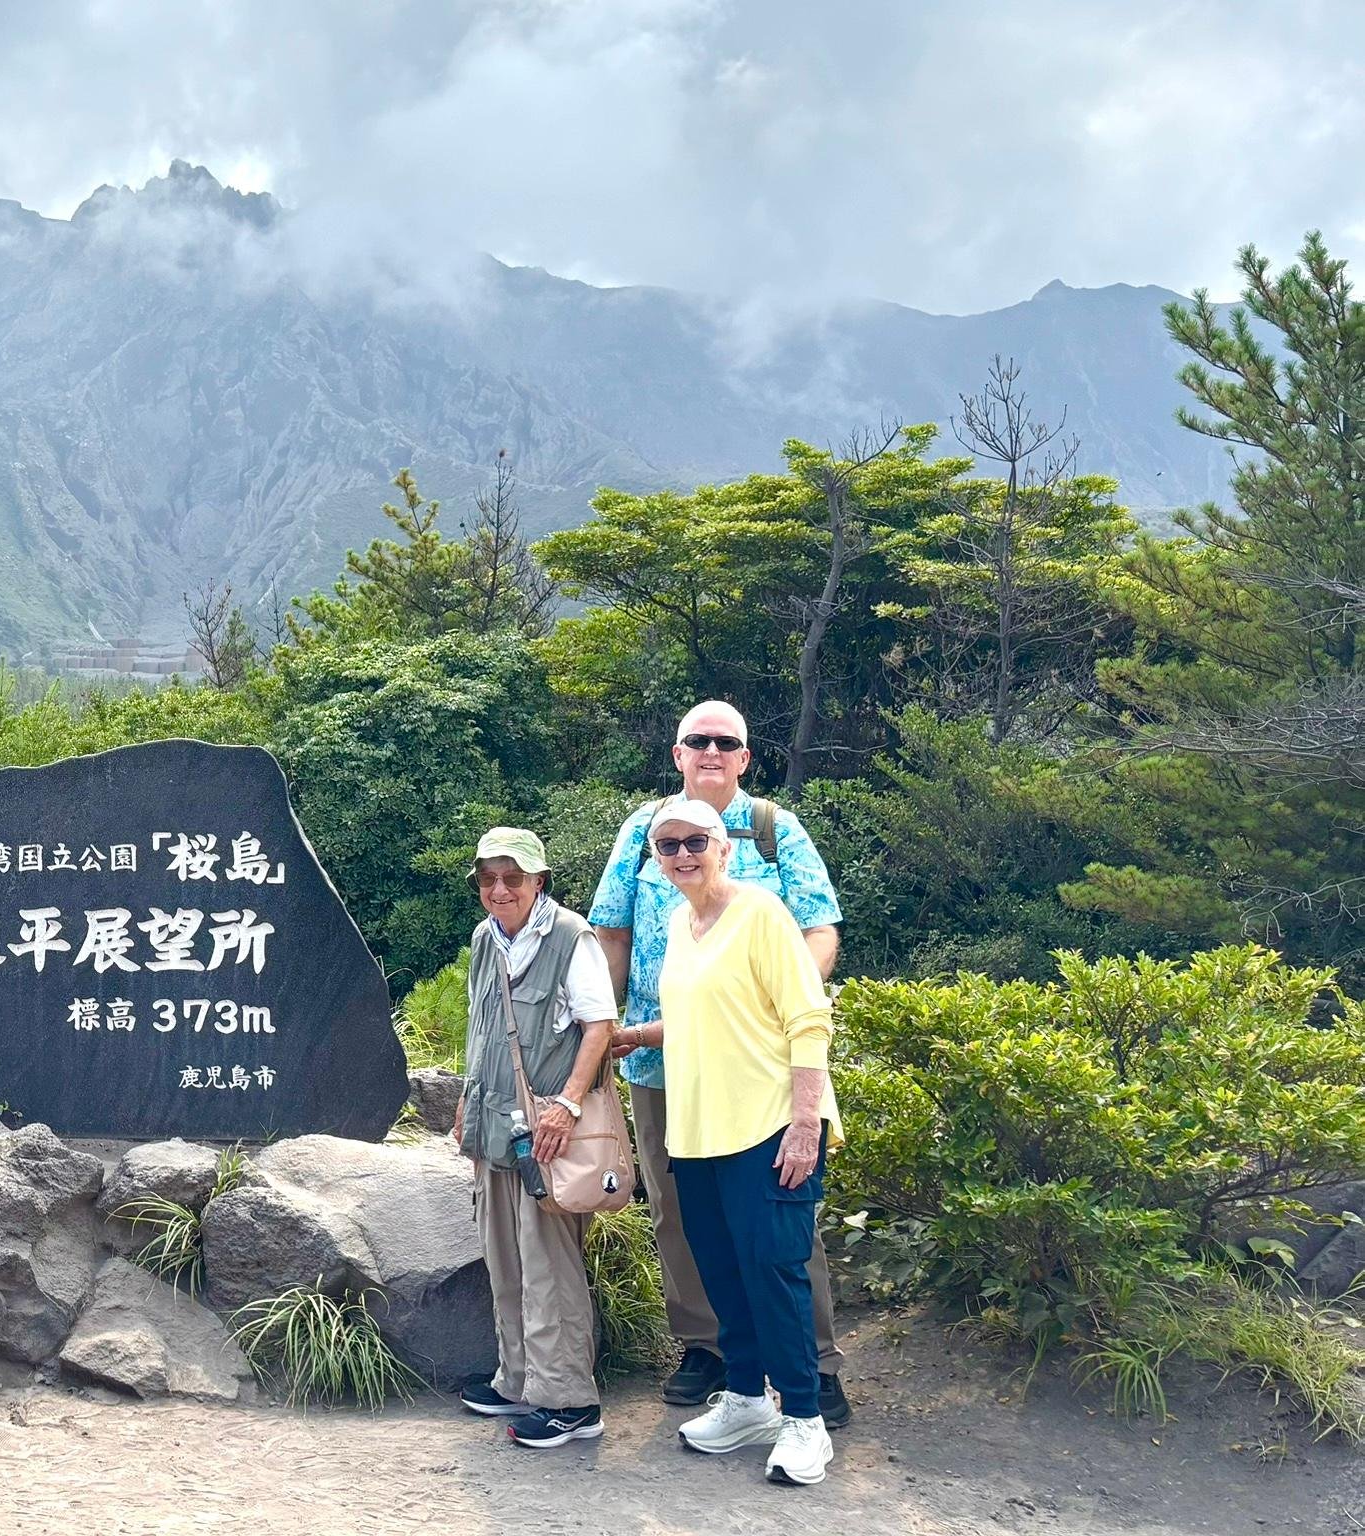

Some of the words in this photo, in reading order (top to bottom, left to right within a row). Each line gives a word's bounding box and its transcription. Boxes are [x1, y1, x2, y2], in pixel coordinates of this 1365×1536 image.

[151, 830, 286, 885] 「桜島」
[67, 996, 137, 1032] 標高
[152, 998, 277, 1035] 373m
[178, 1064, 277, 1091] 鹿児島市
